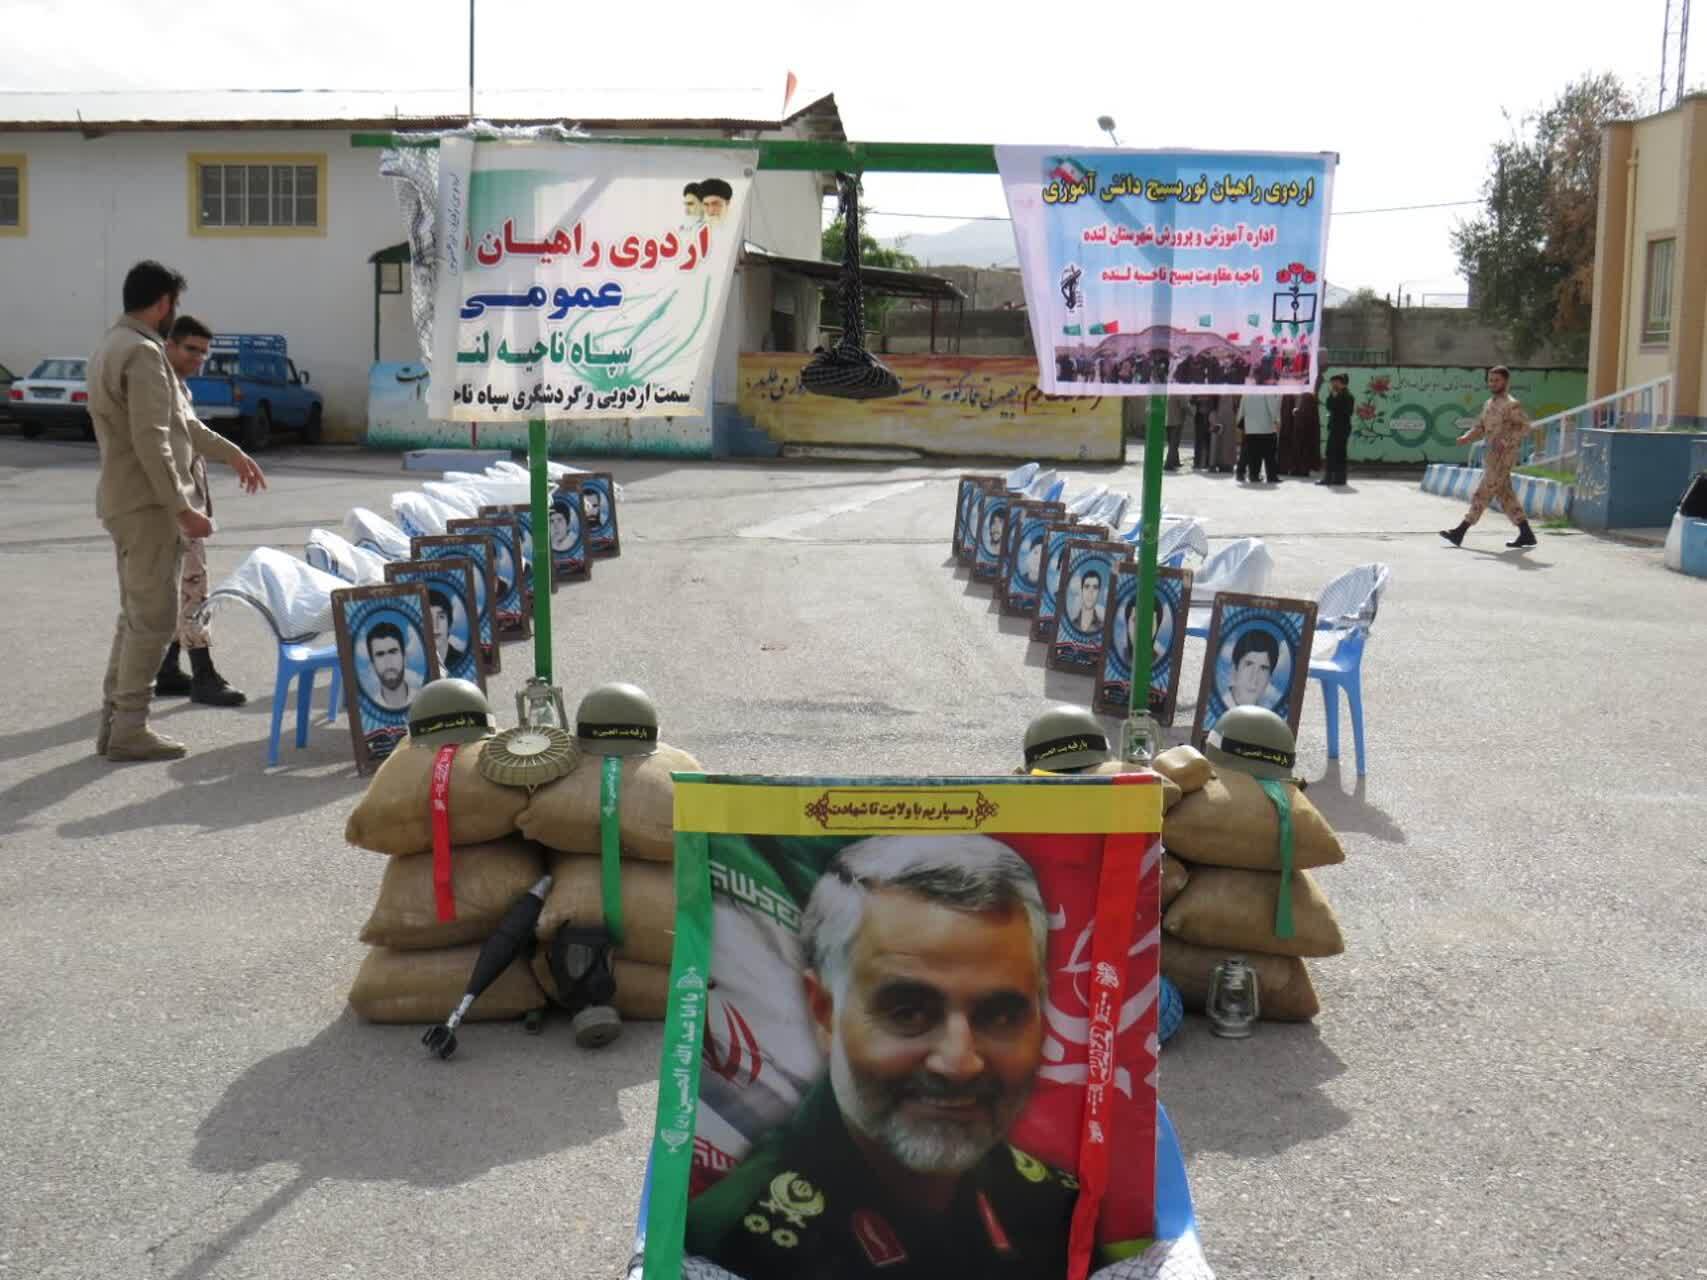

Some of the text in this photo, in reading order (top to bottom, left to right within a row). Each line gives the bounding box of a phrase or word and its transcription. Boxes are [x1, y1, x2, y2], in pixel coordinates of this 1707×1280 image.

[1042, 170, 1314, 206] اردوی راهیان نور بسیج دانش آموزی
[477, 219, 710, 270] اردوی راهیان
[1083, 225, 1275, 247] اداره آموزش و پرورش شهرستان لنده
[1169, 269, 1194, 285] بسیج
[1195, 268, 1232, 286] مقاومت
[1234, 268, 1260, 283] ناحیه
[460, 282, 623, 319] عمومی
[497, 330, 565, 372] ناحیه
[570, 331, 633, 376] سپاه
[477, 385, 510, 412] سپاه
[512, 383, 583, 411] گردشگری
[585, 391, 594, 409] و
[597, 384, 651, 409] اردویی
[654, 382, 694, 404] سمت
[828, 801, 868, 818] شهادت
[869, 801, 880, 816] تا
[880, 801, 912, 821] ولایت
[681, 990, 704, 1003] یا
[680, 1003, 703, 1019] ابا
[680, 1019, 702, 1043] عبد
[672, 1043, 694, 1065] الله
[672, 1066, 695, 1113] الحسین
